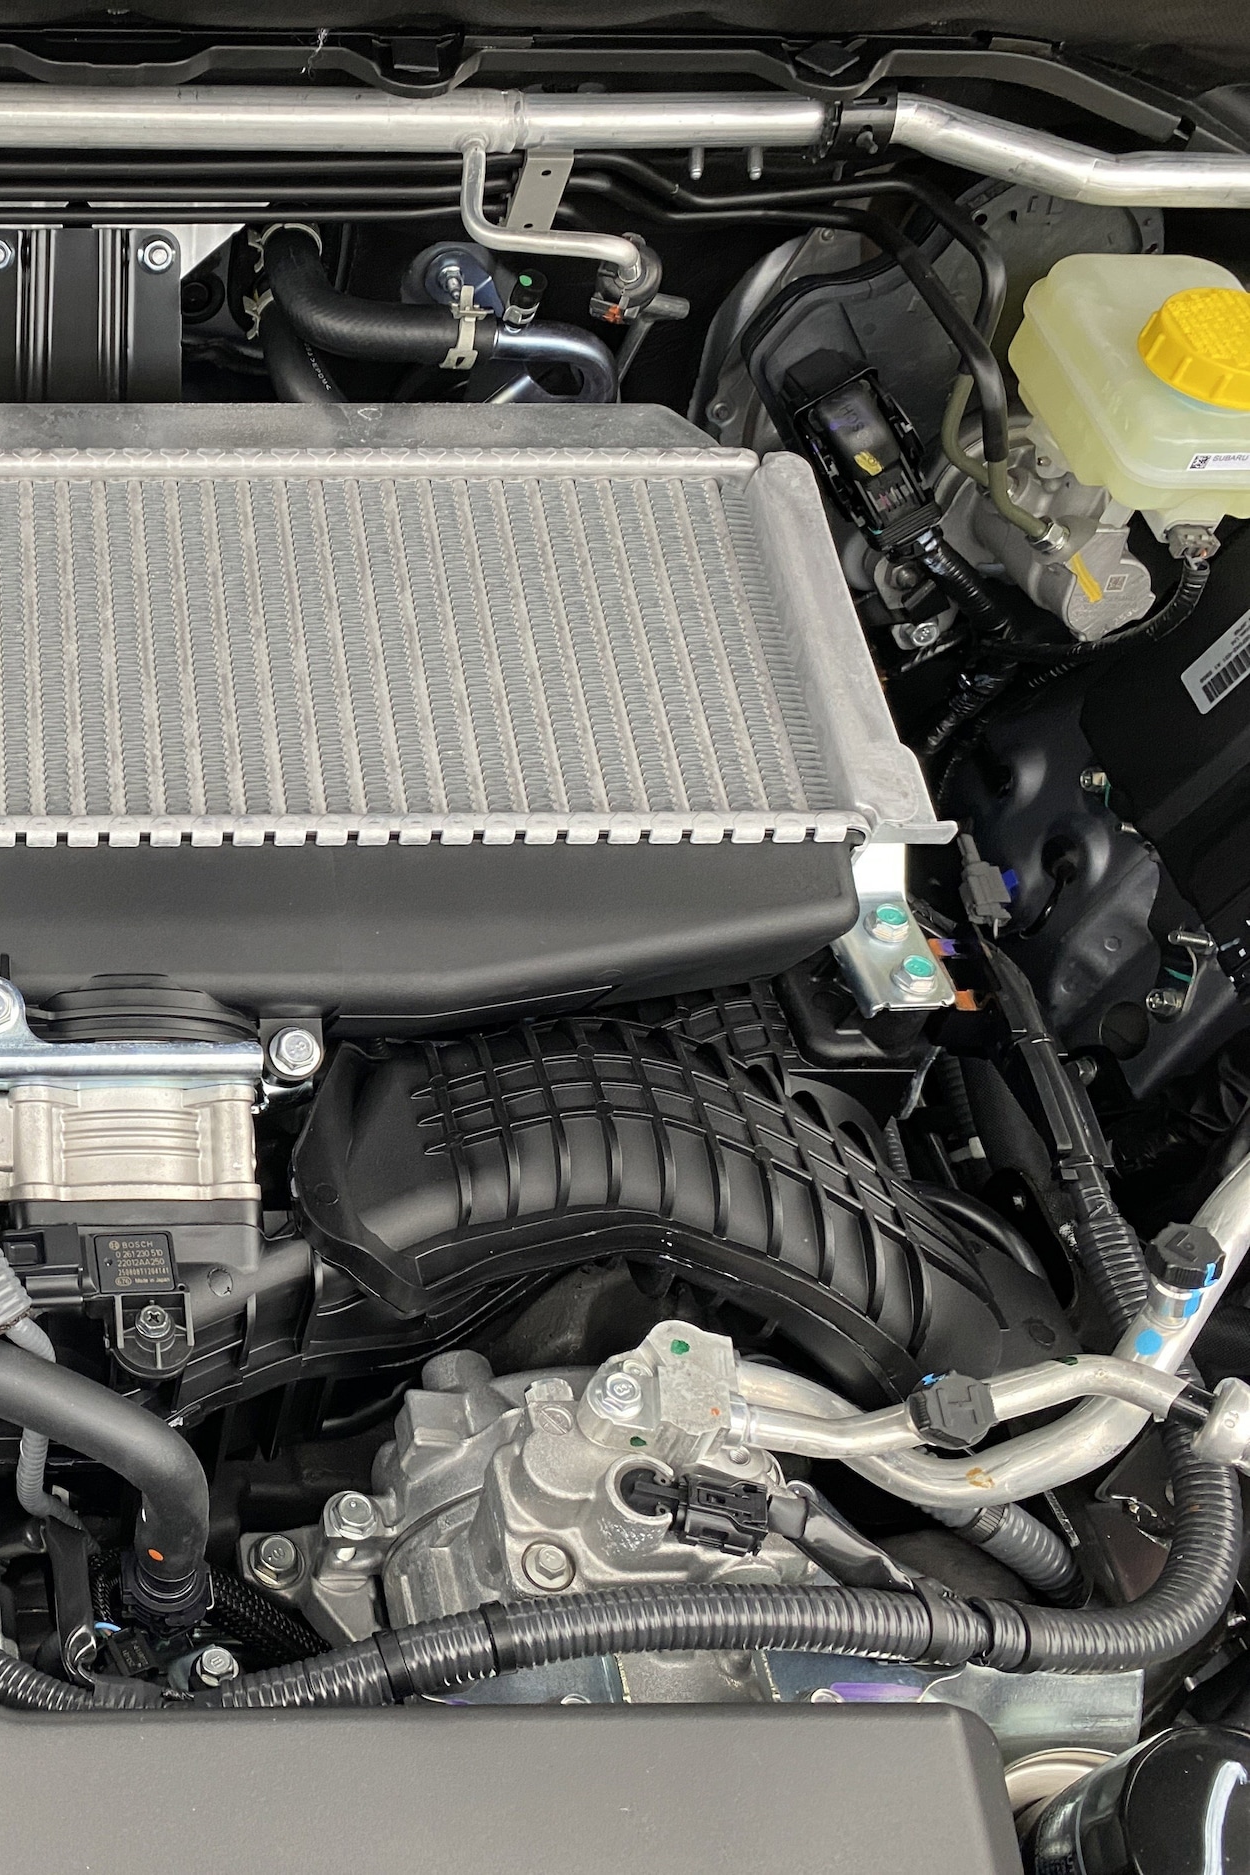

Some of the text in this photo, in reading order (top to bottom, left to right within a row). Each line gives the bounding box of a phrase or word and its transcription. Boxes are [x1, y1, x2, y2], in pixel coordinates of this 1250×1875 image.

[1212, 454, 1249, 462] SUBARU
[121, 1241, 154, 1249] BOSCH
[115, 1249, 163, 1258] 0 261 230 510
[117, 1258, 165, 1267] 22012AA250
